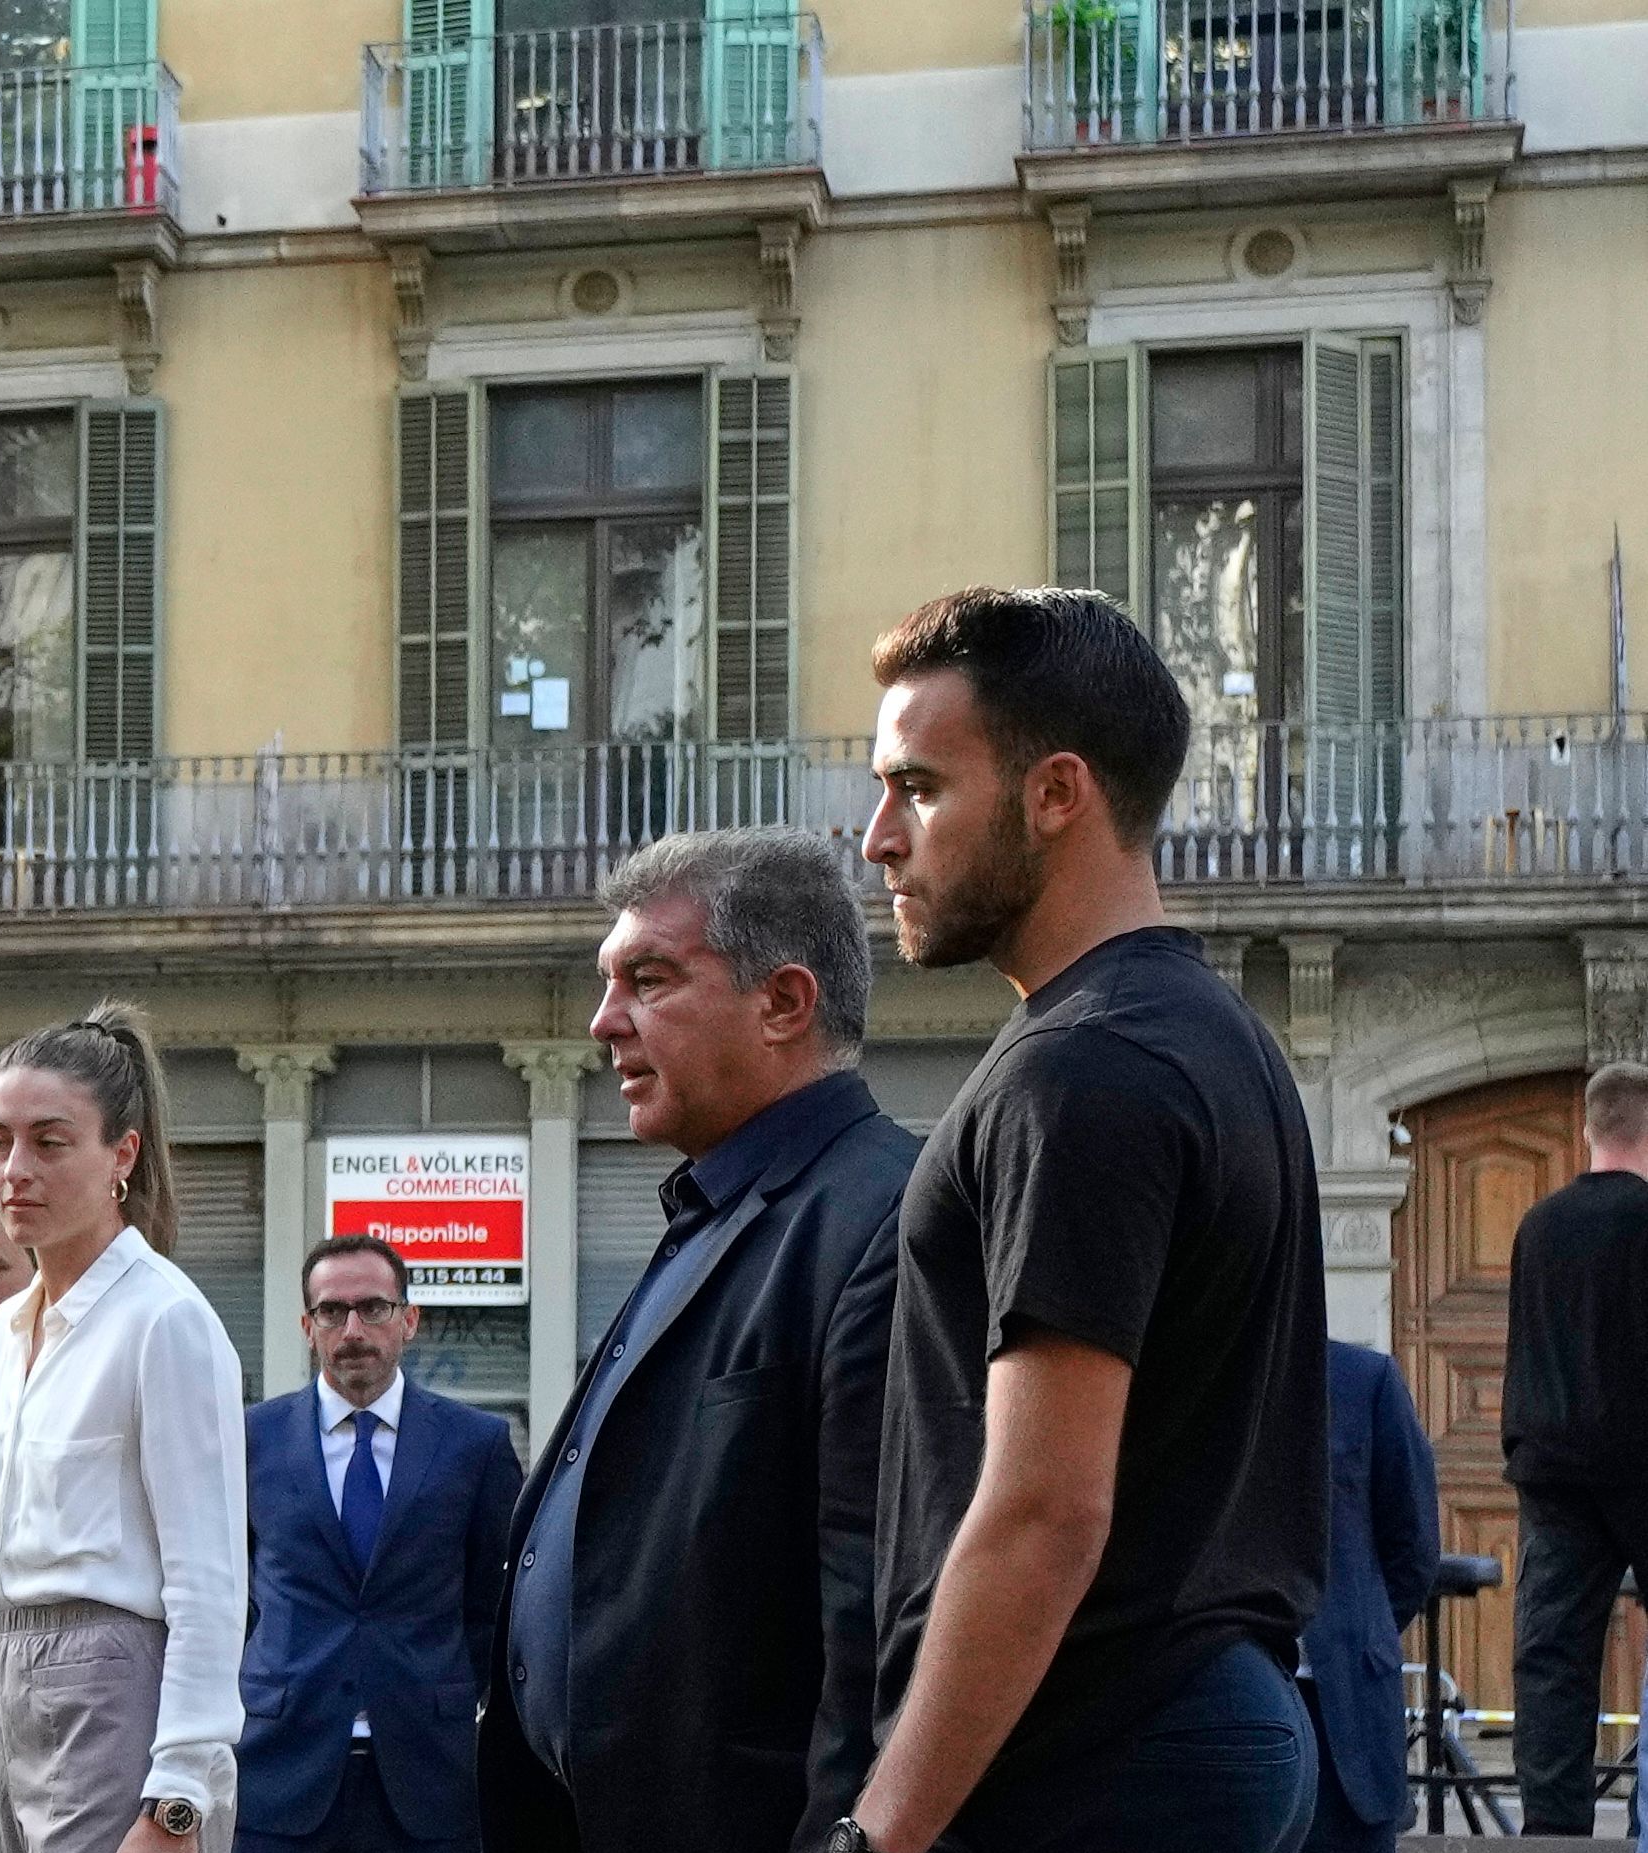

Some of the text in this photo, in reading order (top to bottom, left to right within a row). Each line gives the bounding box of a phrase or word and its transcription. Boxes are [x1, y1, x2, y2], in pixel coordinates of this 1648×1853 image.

[332, 1152, 524, 1174] ENGEL&VÖLKERS
[386, 1178, 524, 1196] COMMERCIAL
[368, 1222, 489, 1245] Disponible
[452, 1268, 477, 1285] 44
[481, 1268, 505, 1285] 44
